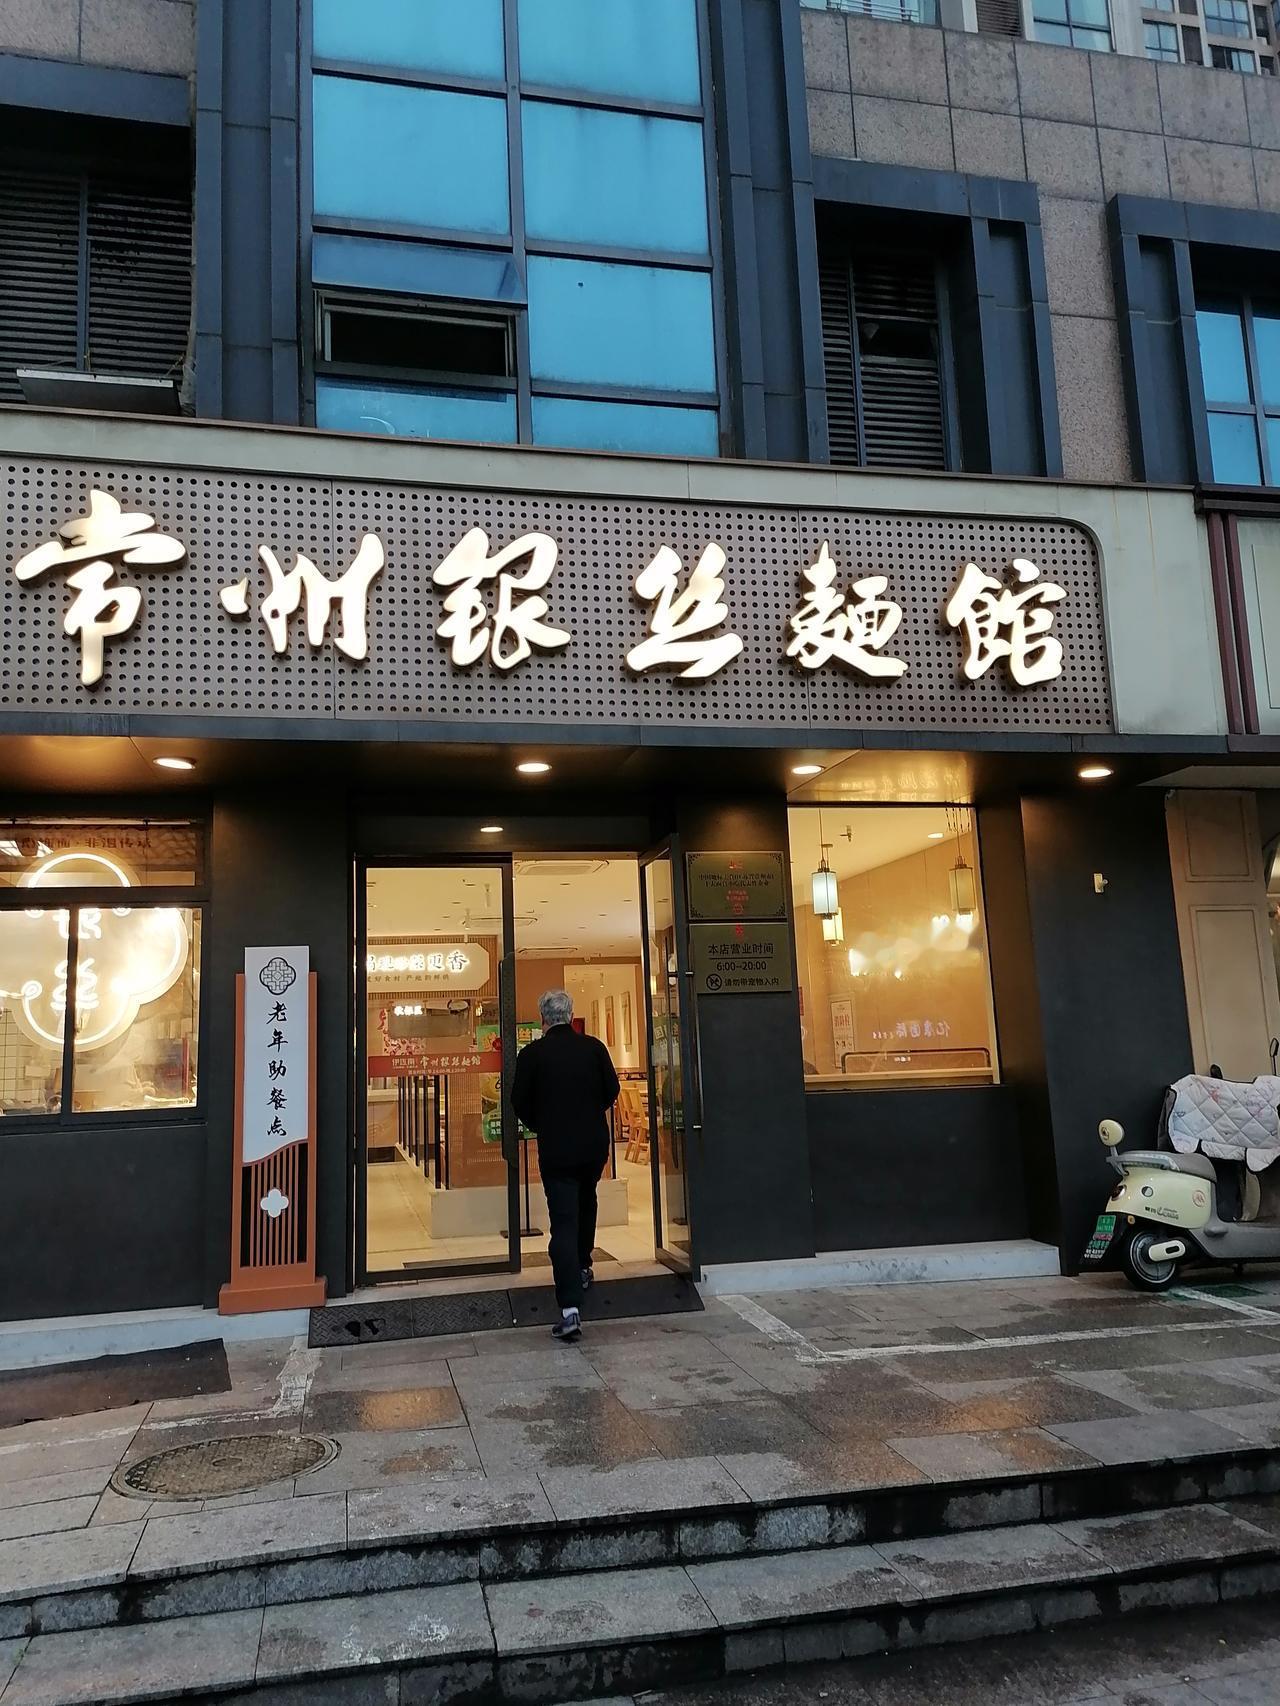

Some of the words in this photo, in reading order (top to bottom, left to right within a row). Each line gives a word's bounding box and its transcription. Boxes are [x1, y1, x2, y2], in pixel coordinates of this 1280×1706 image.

[708, 943, 774, 956] 本店营业时间
[266, 1000, 288, 1137] 老年助餐点
